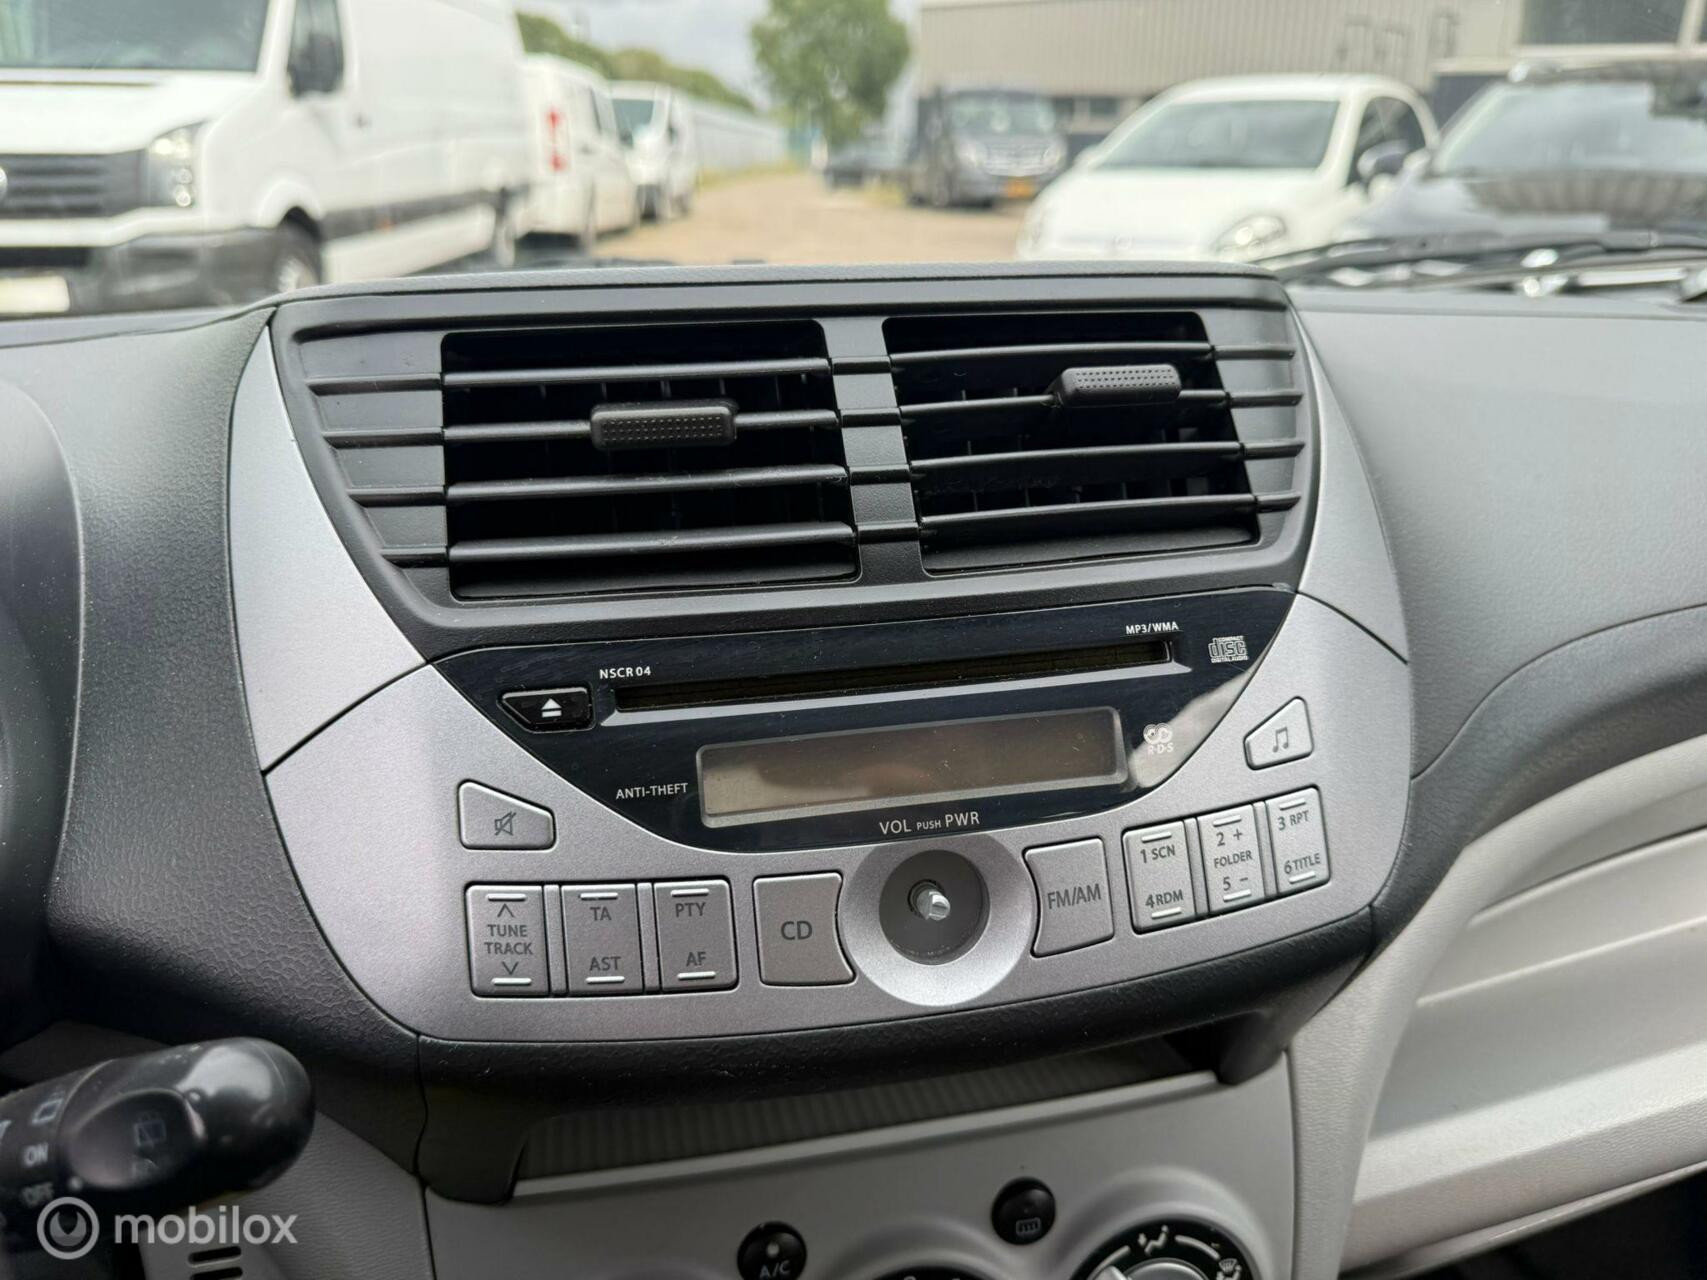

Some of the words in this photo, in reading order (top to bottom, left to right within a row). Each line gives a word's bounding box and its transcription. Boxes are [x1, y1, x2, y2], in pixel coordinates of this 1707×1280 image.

[1126, 621, 1179, 635] MP3/WMA
[599, 667, 634, 679] NSCR
[615, 783, 689, 800] ANTI-THEFT
[879, 819, 912, 835] VOL
[916, 820, 942, 831] PUSH
[945, 811, 980, 828] PWR
[1213, 850, 1253, 869] FOLDER
[1047, 883, 1102, 910] FM/AM
[590, 906, 612, 922] TA
[675, 902, 707, 918] PTY
[487, 924, 528, 938] TUNE
[780, 920, 813, 941] CD
[484, 941, 533, 956] TRACK
[589, 956, 622, 972] AST
[686, 951, 706, 967] AF
[759, 1260, 791, 1279] A/C
